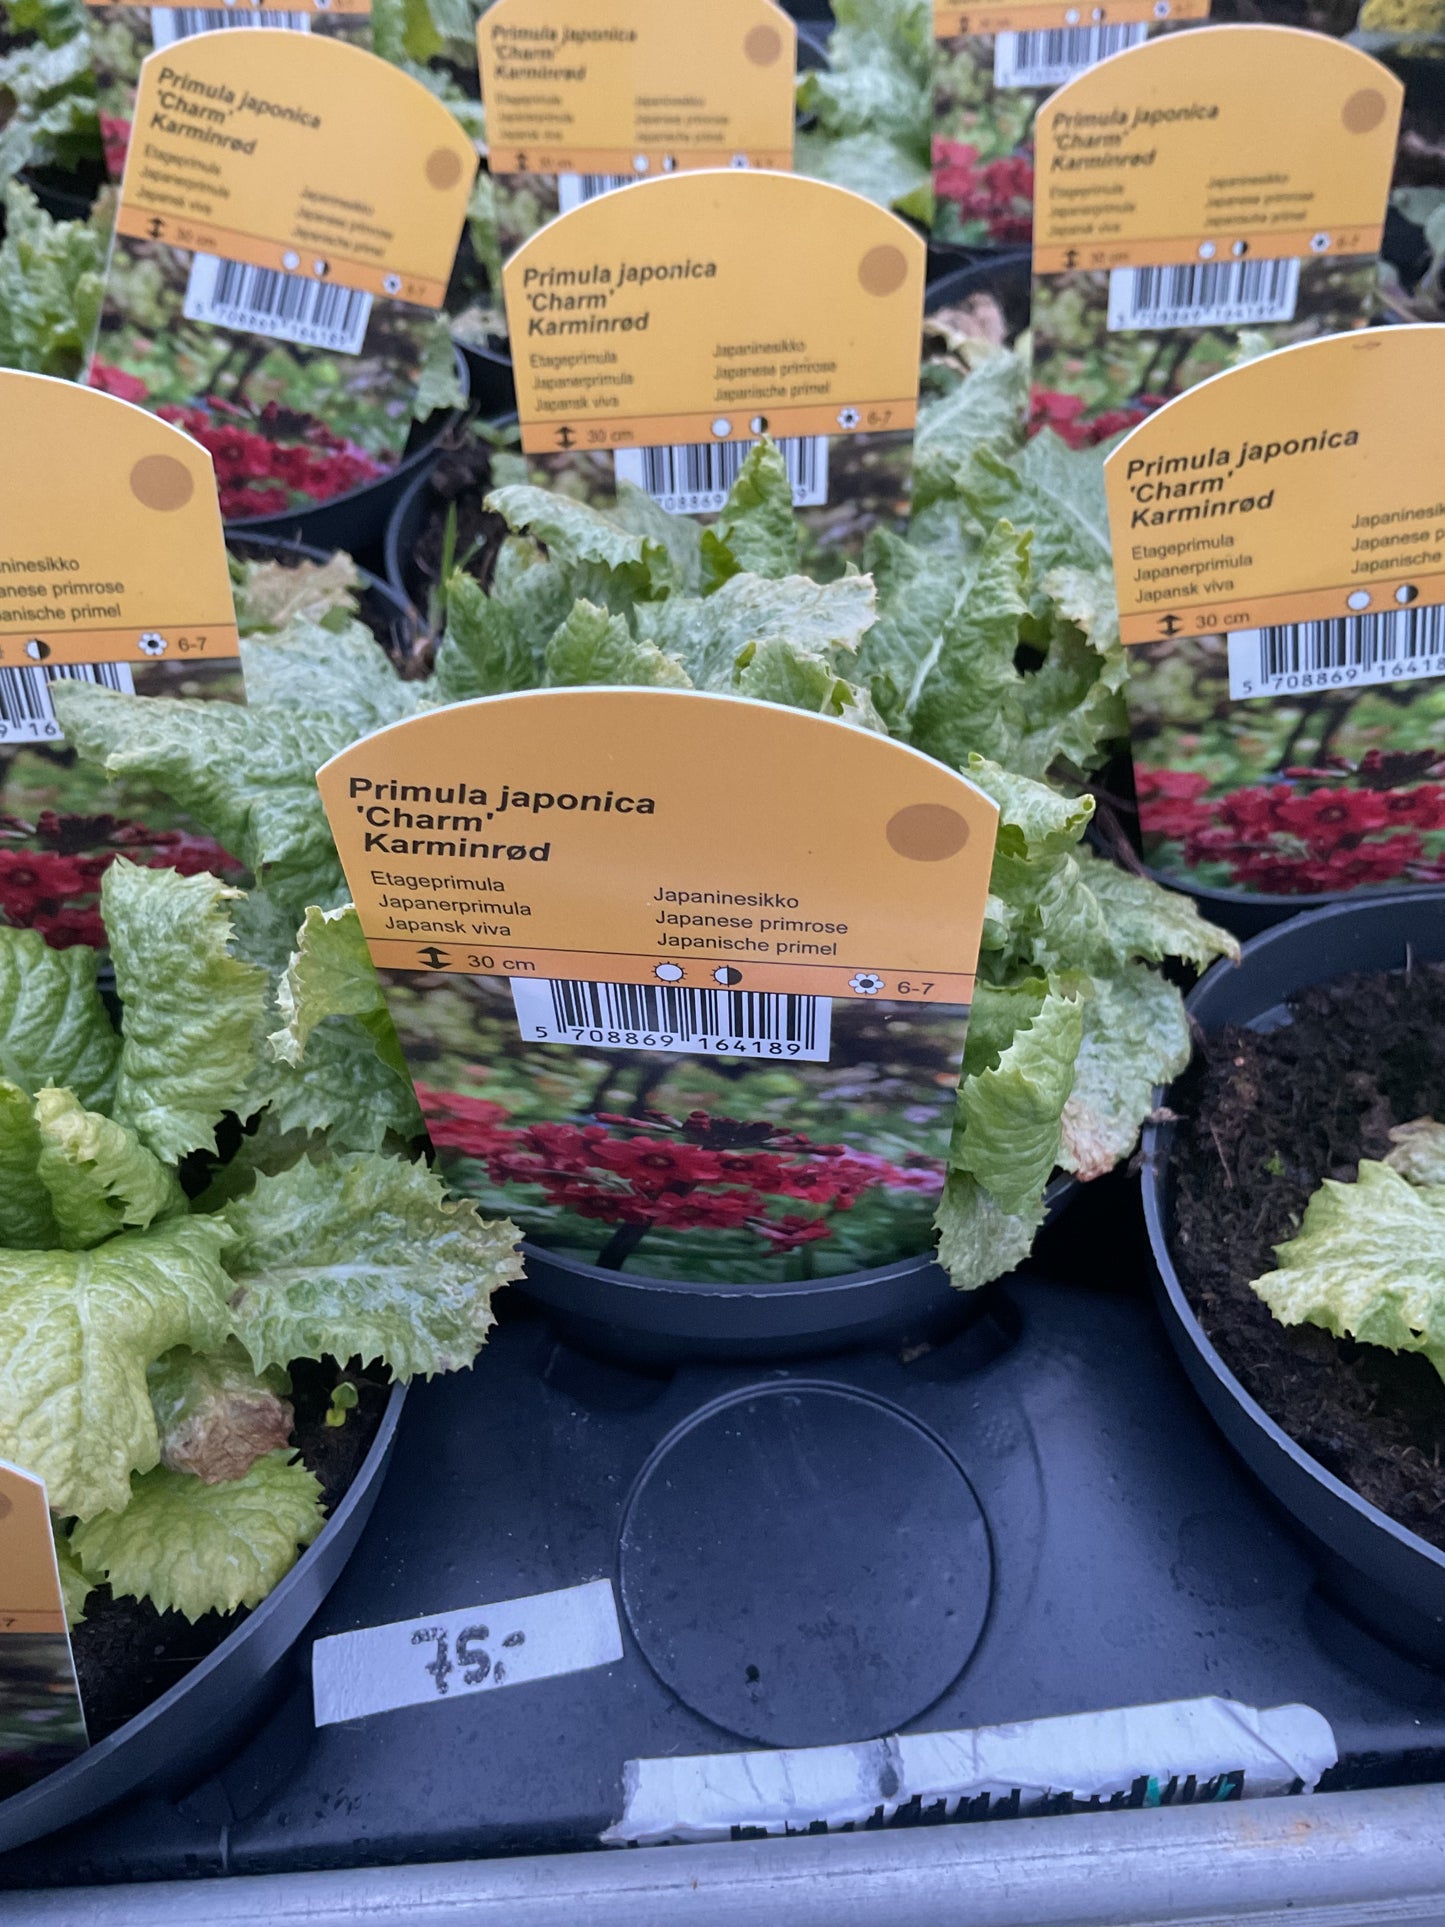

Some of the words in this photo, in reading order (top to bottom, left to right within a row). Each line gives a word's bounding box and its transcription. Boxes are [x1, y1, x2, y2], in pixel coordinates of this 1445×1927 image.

[157, 67, 235, 104] Primula
[238, 91, 321, 129] japonica
[1051, 108, 1128, 131] Primula
[1131, 103, 1218, 129] japonica
[523, 265, 611, 288] Primula
[617, 258, 717, 287] japonica
[526, 289, 615, 312] 'Charm'
[528, 311, 650, 337] Karminrød
[1127, 448, 1231, 480] Primula
[1235, 429, 1359, 469] japonica
[1130, 470, 1233, 503] 'Charm'
[1130, 489, 1275, 530] Karminrød
[1131, 534, 1235, 560] Etageprimula
[1351, 530, 1430, 552] Japanese
[1133, 554, 1253, 582] Japanerprimula
[1351, 551, 1442, 574] Japanische
[52, 581, 125, 599] primrose
[1135, 582, 1198, 604] Japansk
[1203, 579, 1235, 593] viva
[71, 603, 122, 622] primel
[1196, 614, 1217, 629] 30
[1223, 612, 1250, 625] cm
[178, 637, 207, 652] 6-7
[1272, 669, 1357, 690] 708869
[349, 777, 487, 805] Primula
[495, 786, 655, 814] japonica
[357, 805, 494, 832] 'Charm'
[364, 832, 551, 861] Karminrød
[371, 870, 505, 892] Etageprimula
[379, 894, 531, 916] Japanerprimula
[653, 887, 799, 909] Japaninesikko
[385, 916, 466, 934] Japansk
[472, 921, 511, 937] viva
[655, 910, 753, 930] Japanese
[760, 916, 848, 935] primrose
[657, 932, 769, 953] Japanische
[776, 938, 837, 956] primel
[468, 955, 495, 969] 30
[502, 958, 536, 971] cm
[897, 980, 935, 996] 6-7
[535, 1026, 549, 1039] 5
[570, 1029, 674, 1048] 708869
[698, 1038, 801, 1057] 164189
